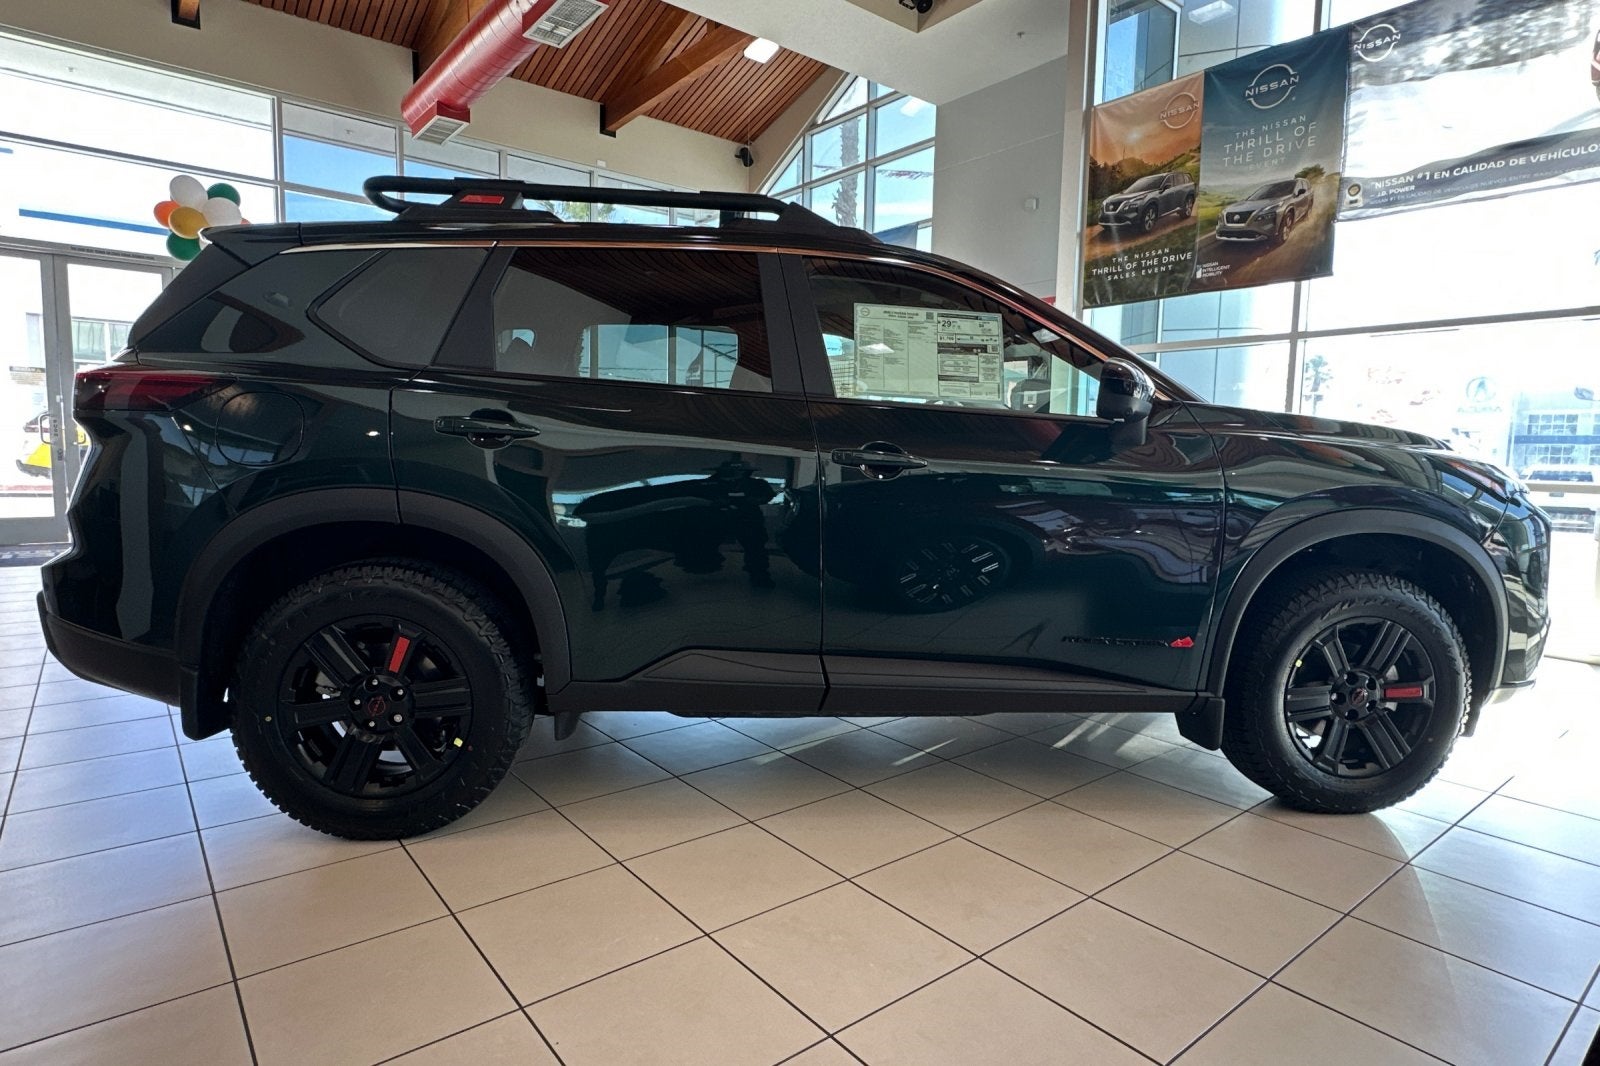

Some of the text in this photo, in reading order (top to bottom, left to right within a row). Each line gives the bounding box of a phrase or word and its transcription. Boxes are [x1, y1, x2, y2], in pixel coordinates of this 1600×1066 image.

[1353, 33, 1401, 50] NISSAN
[1245, 75, 1299, 97] NISSAN
[1160, 101, 1200, 119] NISSAN
[1235, 115, 1306, 139] THE NISSAN
[1224, 122, 1317, 154] THRILL OF
[1222, 136, 1317, 167] THE DRIVE
[1249, 157, 1287, 171] EVENT
[1417, 172, 1430, 180] #1
[1434, 170, 1450, 180] EN
[1454, 161, 1505, 176] CALIDAD
[1509, 157, 1526, 166] DE
[1389, 185, 1415, 194] POWER
[1134, 248, 1170, 258] NISSAN
[1092, 252, 1193, 276] THRILL OF THE DRIVE
[1107, 265, 1173, 281] SALES EVENT
[942, 320, 952, 328] 29
